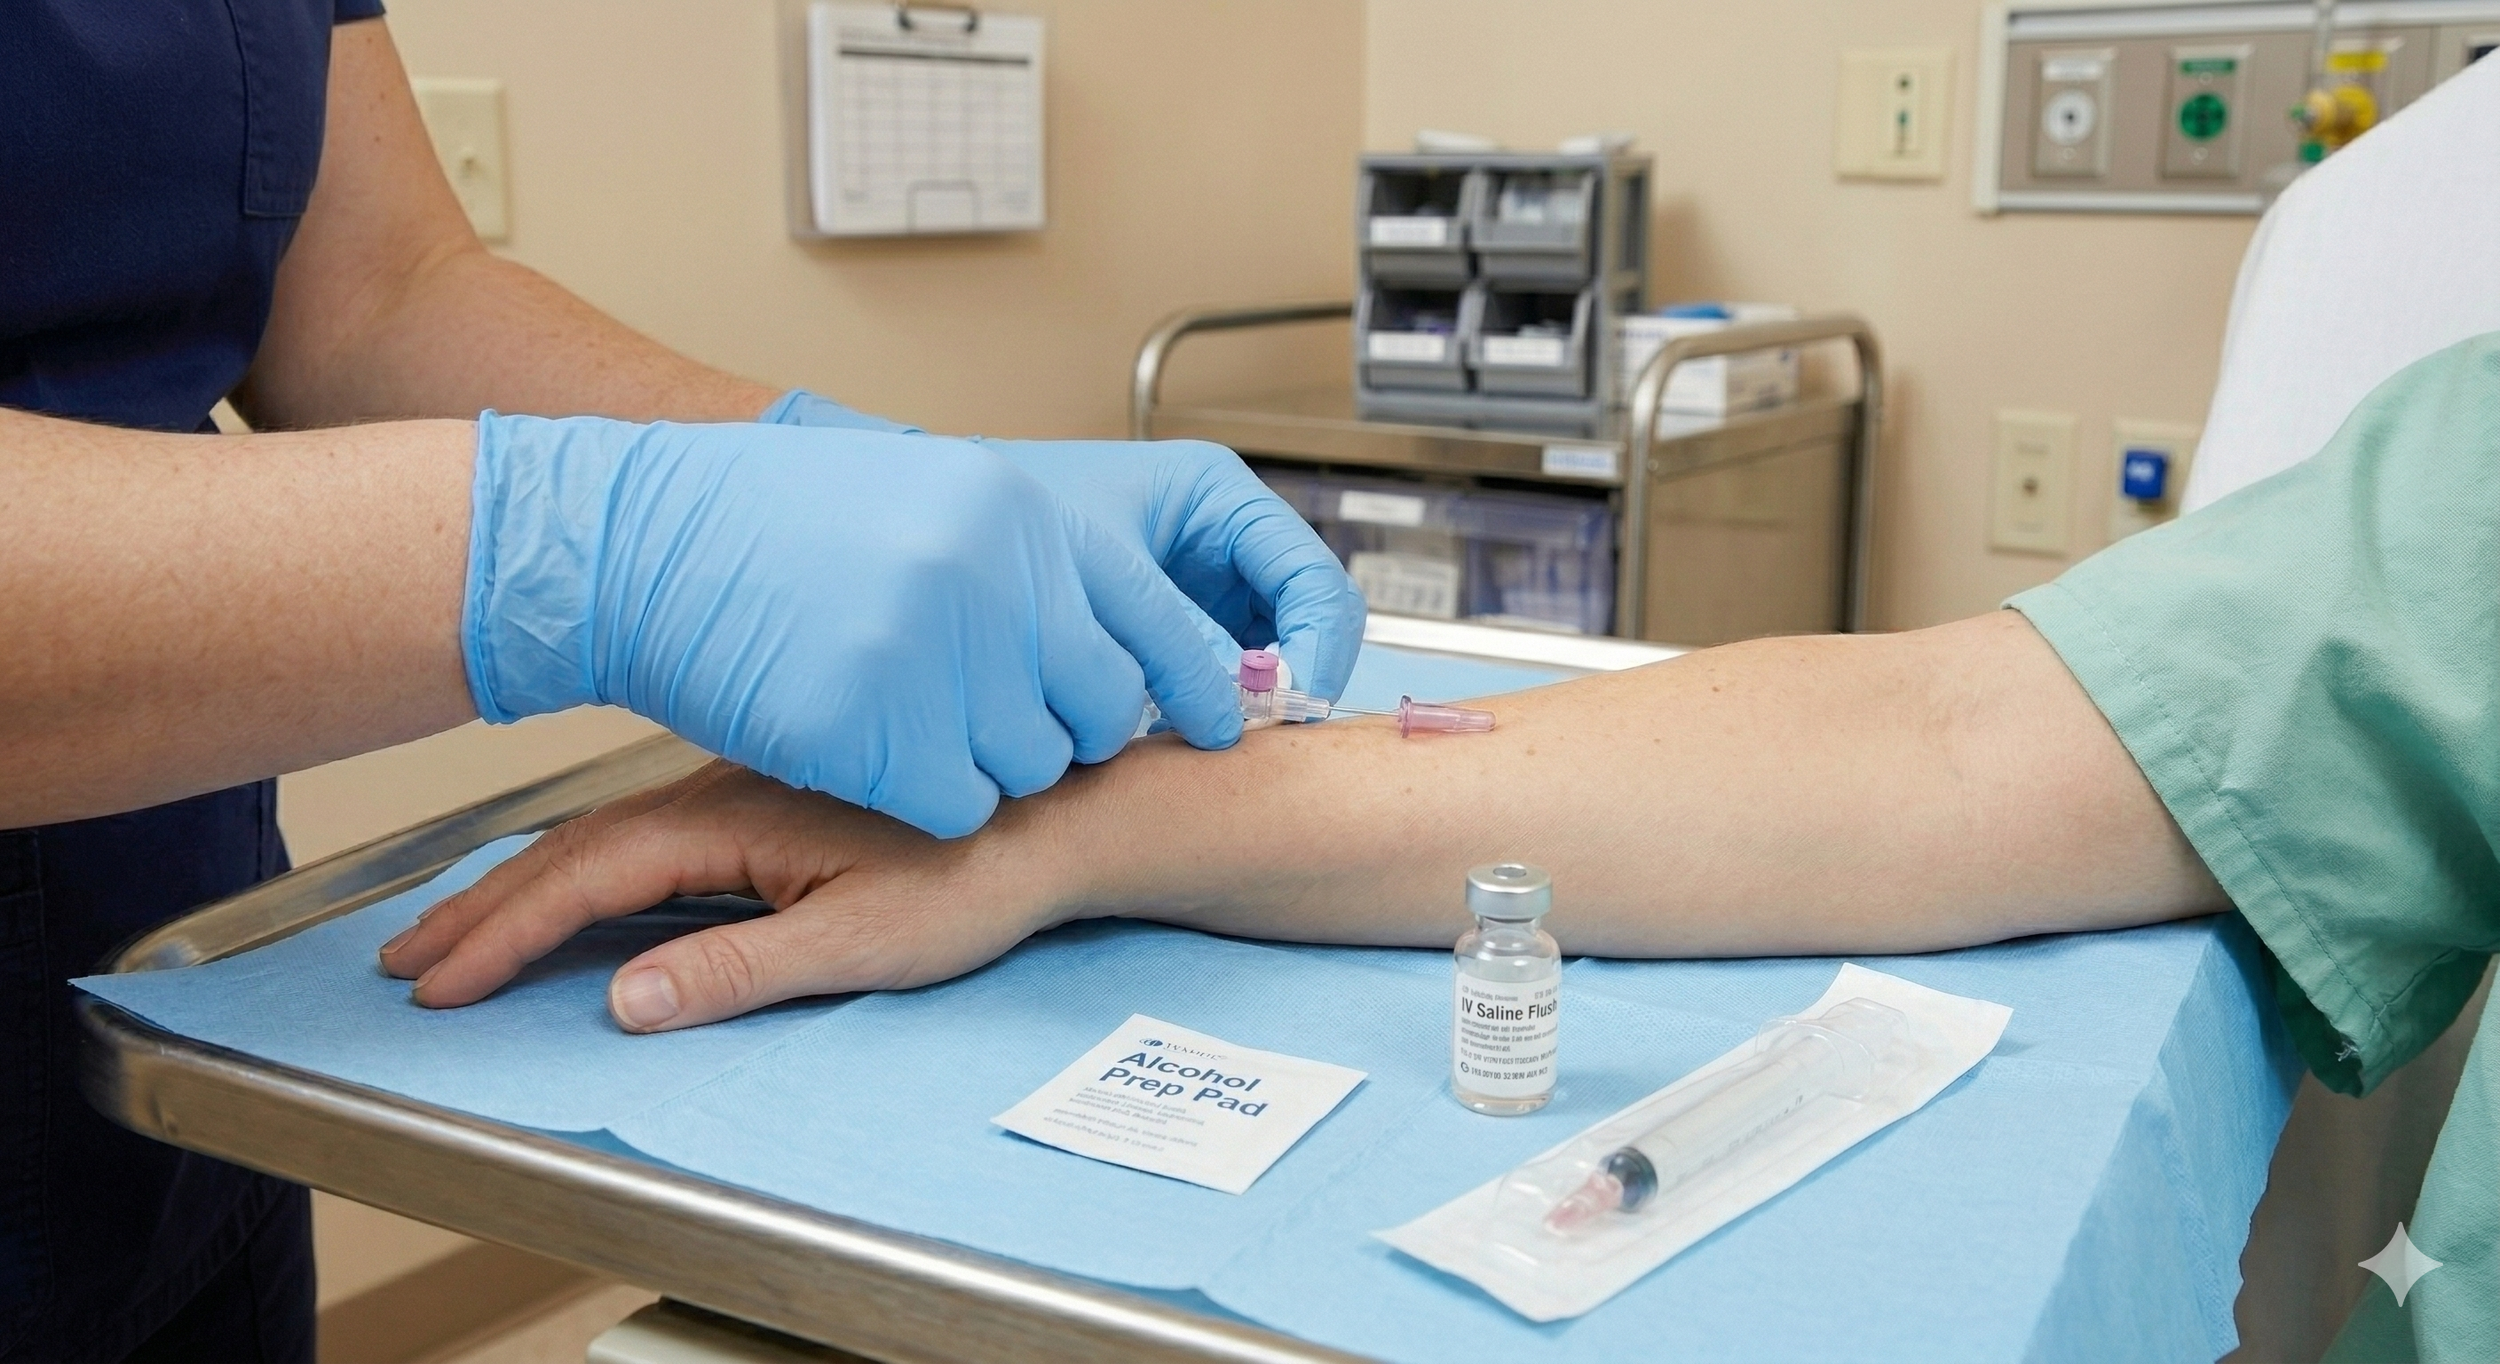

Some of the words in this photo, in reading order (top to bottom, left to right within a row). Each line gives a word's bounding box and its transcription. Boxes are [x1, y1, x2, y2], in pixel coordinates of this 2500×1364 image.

[1462, 997, 1473, 1014] IV
[1476, 1002, 1523, 1021] Saline
[1528, 998, 1557, 1019] Flush
[1099, 1066, 1185, 1098] Prep
[1193, 1087, 1269, 1117] Pad
[1117, 1052, 1262, 1092] Alcohol
